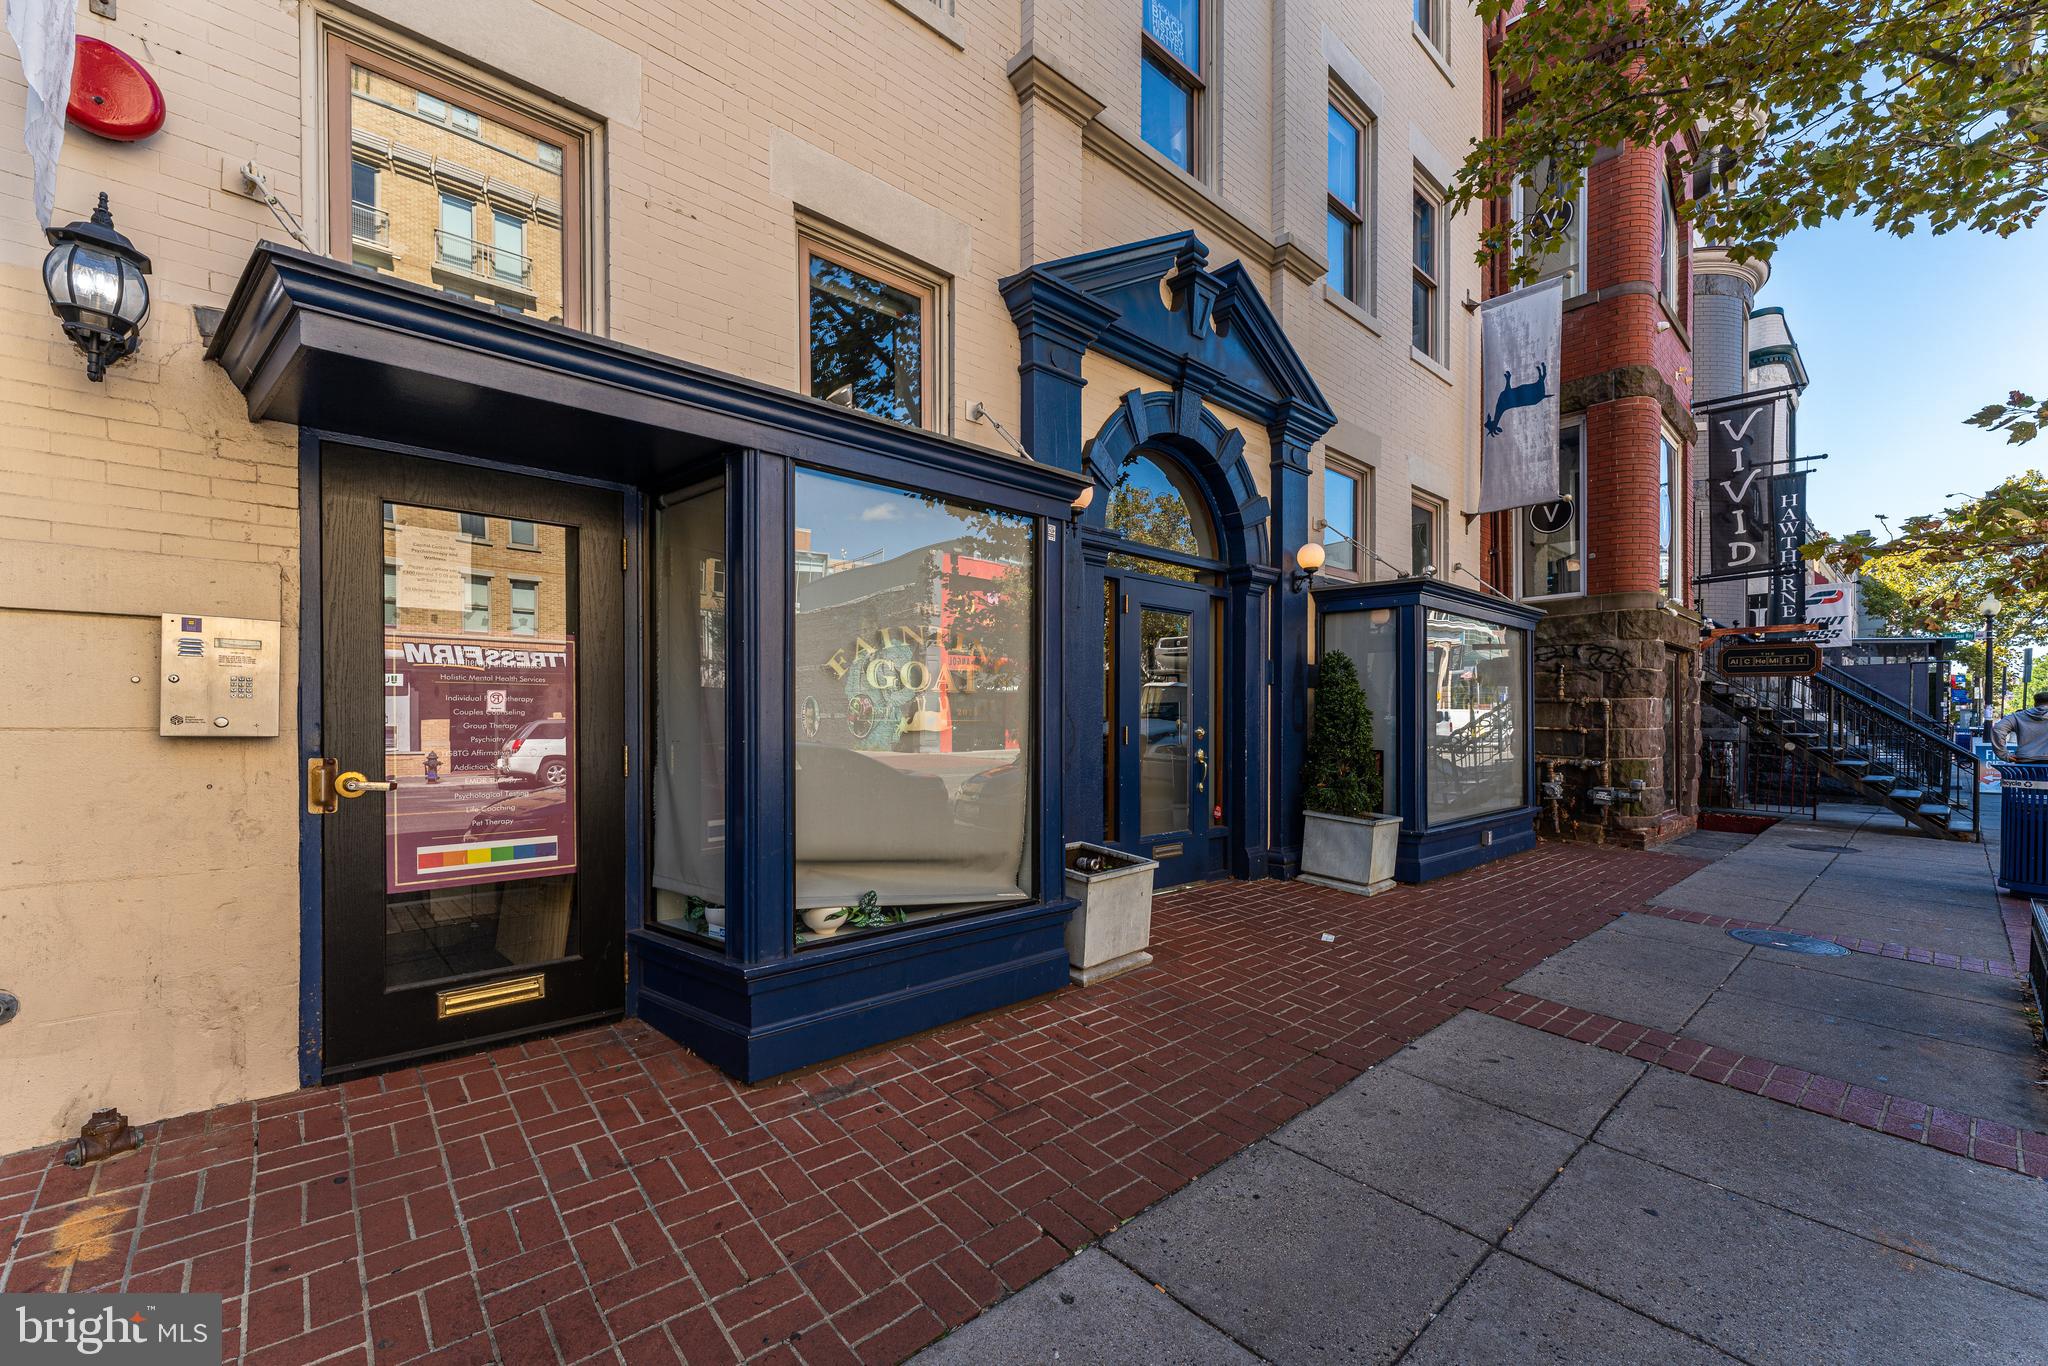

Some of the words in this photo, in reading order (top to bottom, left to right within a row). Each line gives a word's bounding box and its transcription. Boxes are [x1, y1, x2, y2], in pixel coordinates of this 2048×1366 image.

[1152, 4, 1184, 40] BLACK
[1152, 16, 1184, 51] HISTORY
[1152, 26, 1185, 61] MATTER
[1719, 407, 1763, 567] VIVID
[1543, 503, 1559, 523] V
[440, 673, 467, 681] Holistic
[468, 674, 493, 682] Mental
[495, 675, 518, 683] Health
[866, 658, 980, 694] GOAT
[453, 708, 484, 717] Couples
[463, 722, 487, 730] Group
[489, 722, 518, 730] Therapy
[470, 736, 506, 744] Psychiatry
[454, 791, 503, 800] Psychological
[505, 790, 530, 798] Testing
[486, 818, 514, 826] Therapy
